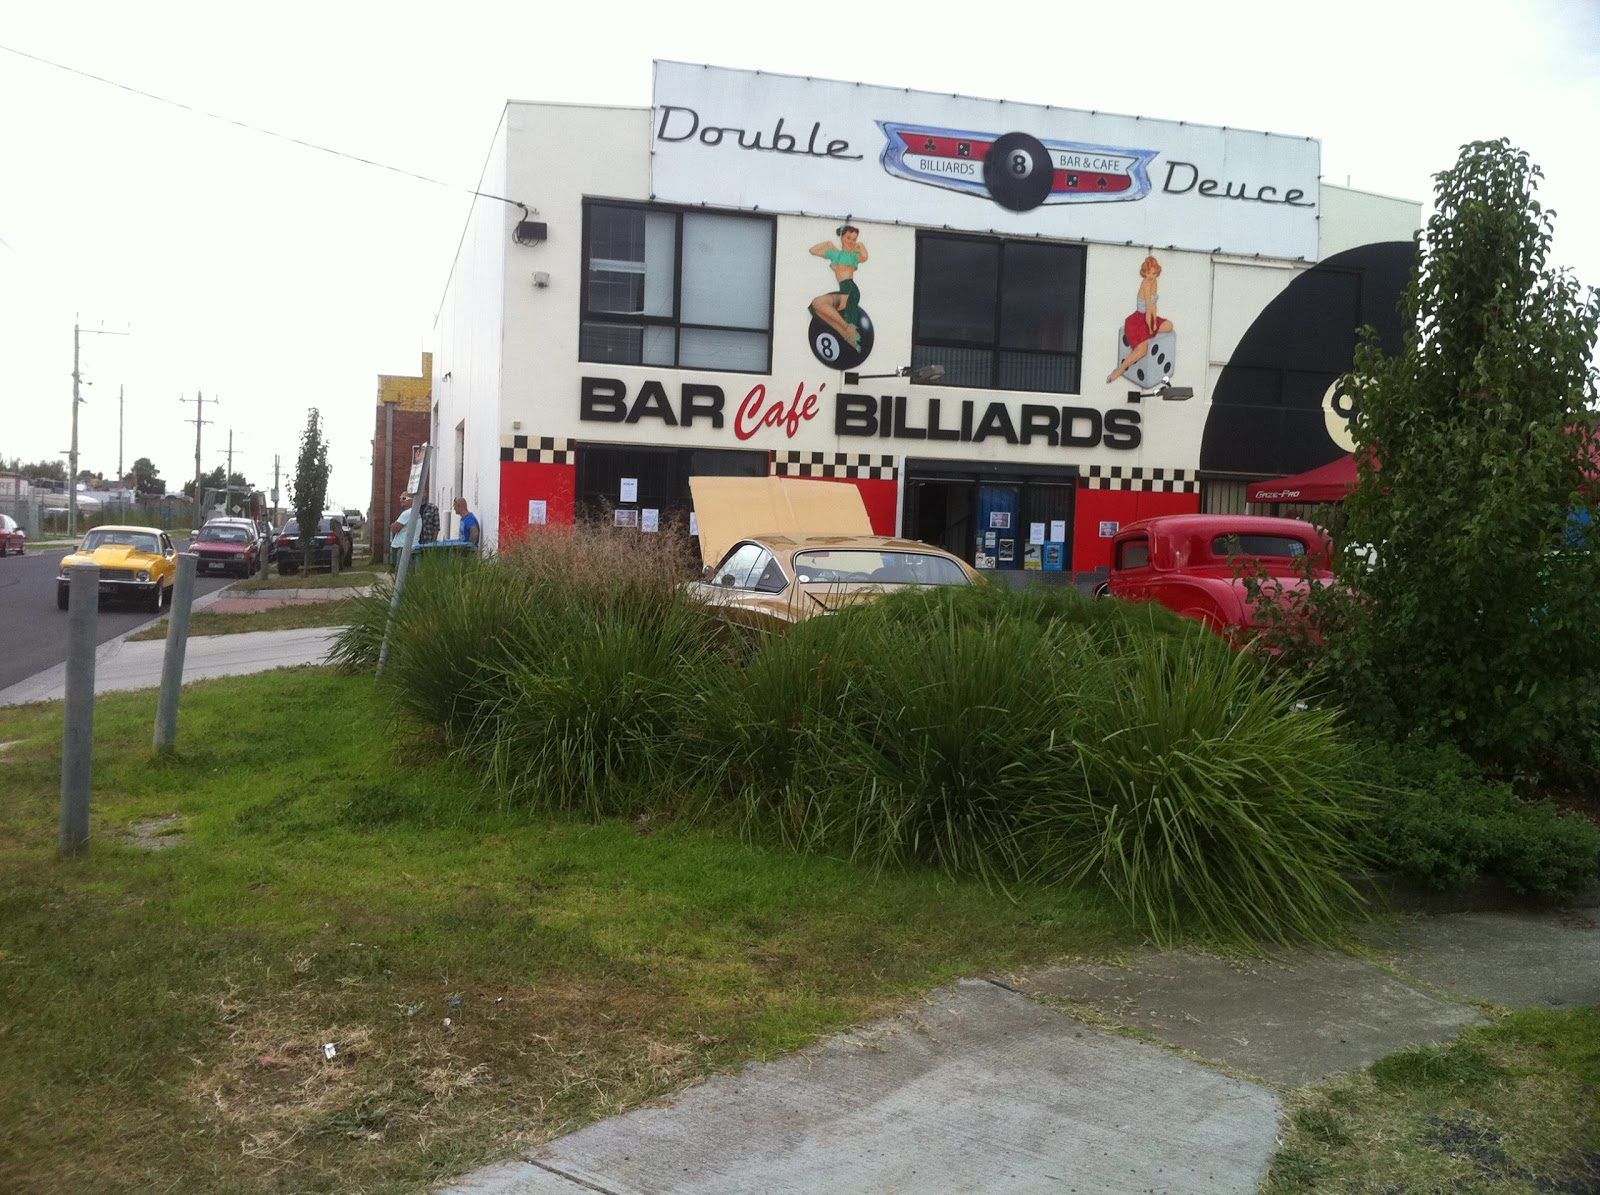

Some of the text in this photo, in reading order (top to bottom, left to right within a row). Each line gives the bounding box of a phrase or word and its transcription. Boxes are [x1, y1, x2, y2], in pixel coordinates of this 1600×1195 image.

[657, 104, 1316, 207] Double Deuce
[1012, 154, 1026, 175] 8
[1059, 154, 1120, 172] BAR & CAFE
[919, 158, 975, 176] BILLIARDS
[820, 336, 834, 359] 8
[580, 376, 1142, 449] BAR Café BILLIARDS
